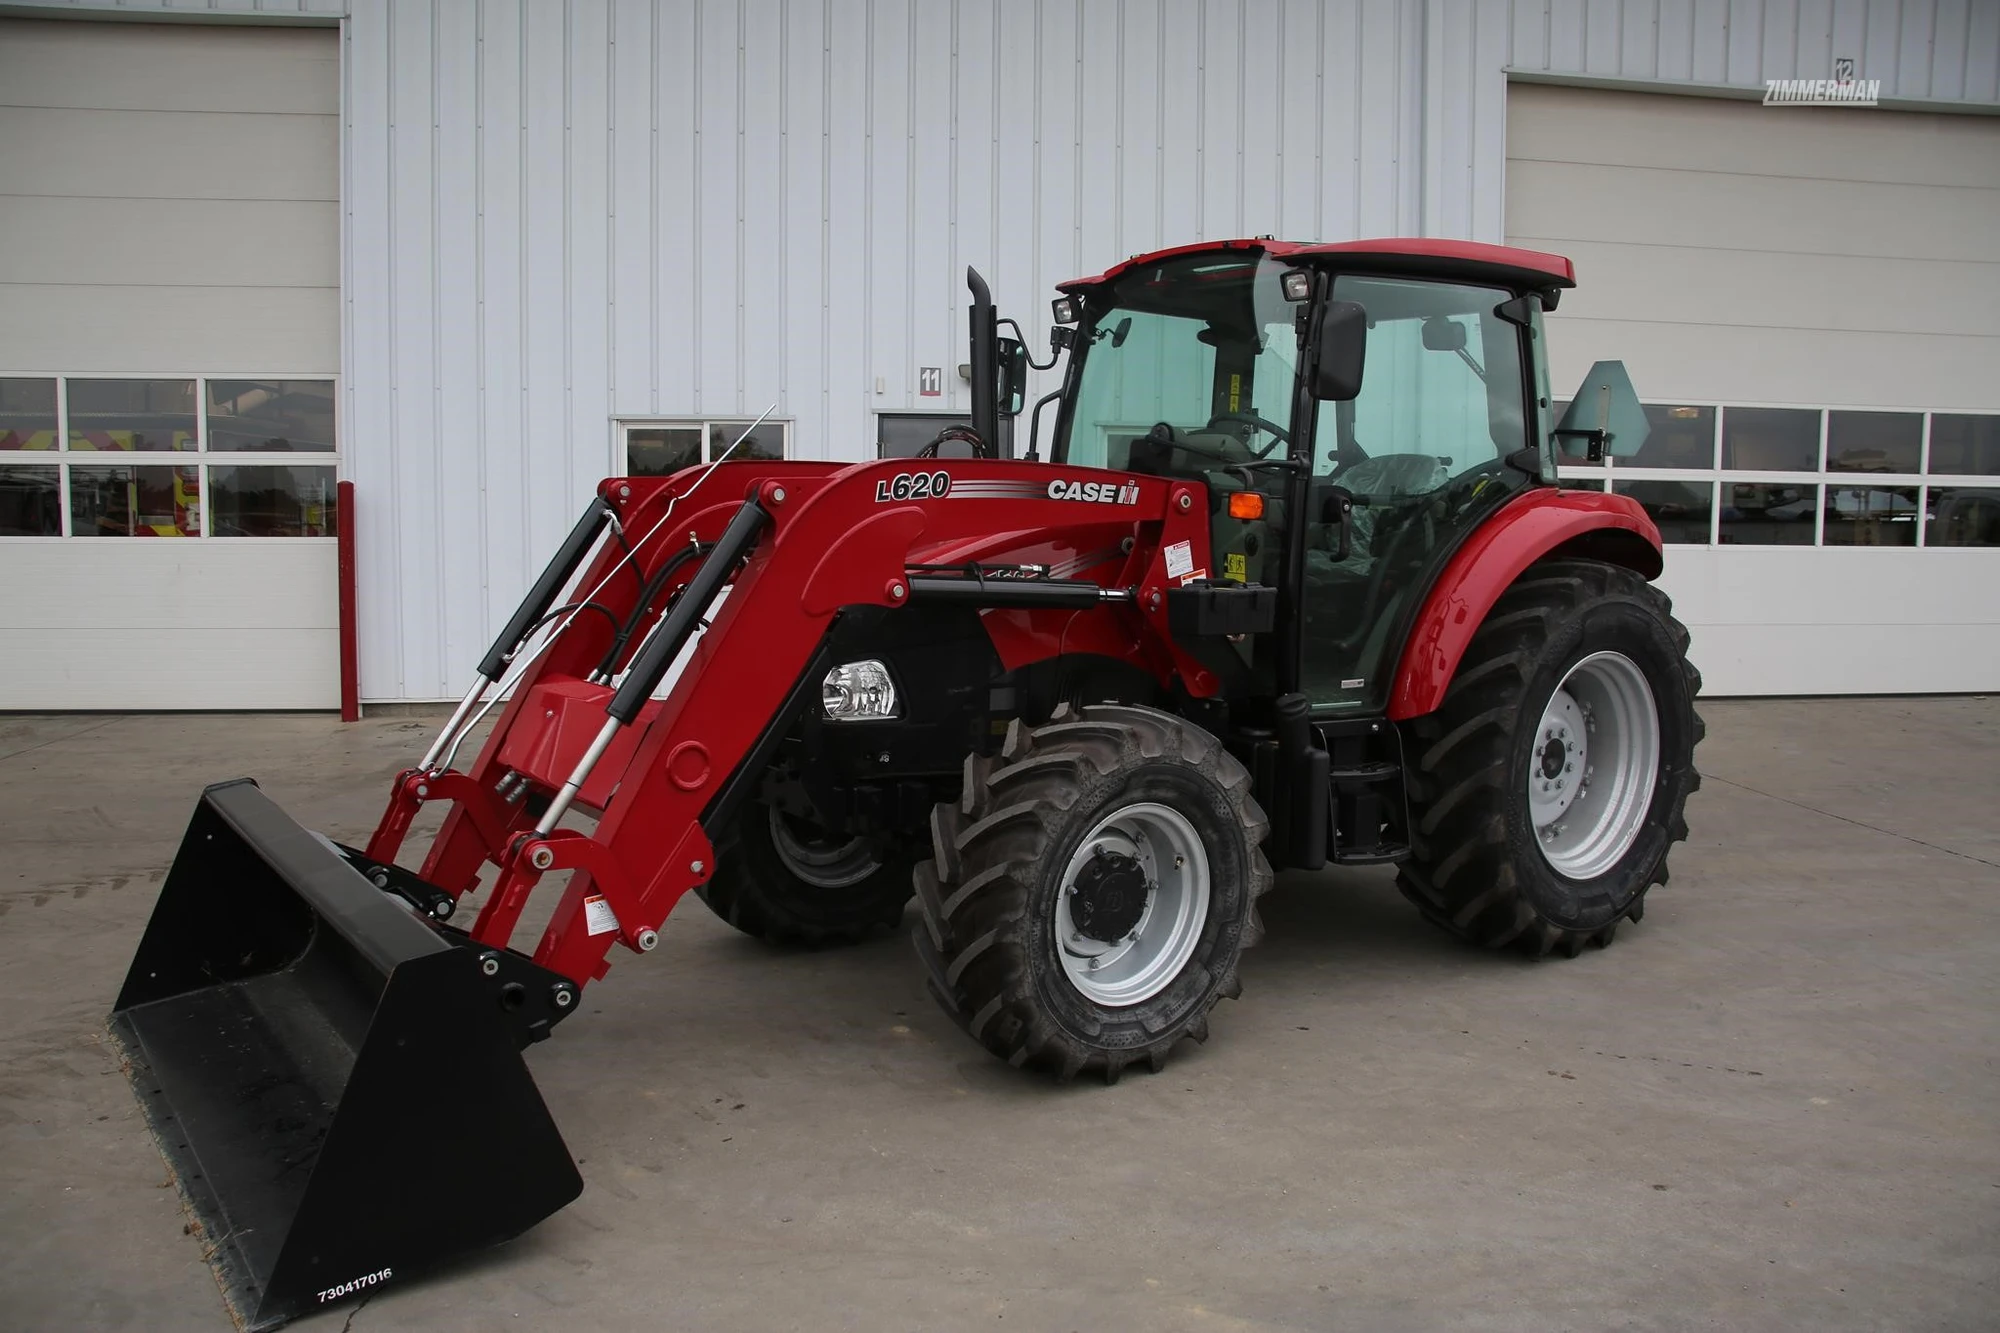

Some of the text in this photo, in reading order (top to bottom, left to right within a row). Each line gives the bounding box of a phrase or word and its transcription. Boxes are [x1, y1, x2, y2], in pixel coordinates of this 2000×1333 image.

[921, 369, 939, 391] 11
[875, 470, 950, 503] L620
[1047, 479, 1117, 503] CASE
[317, 1267, 392, 1303] 730417016
